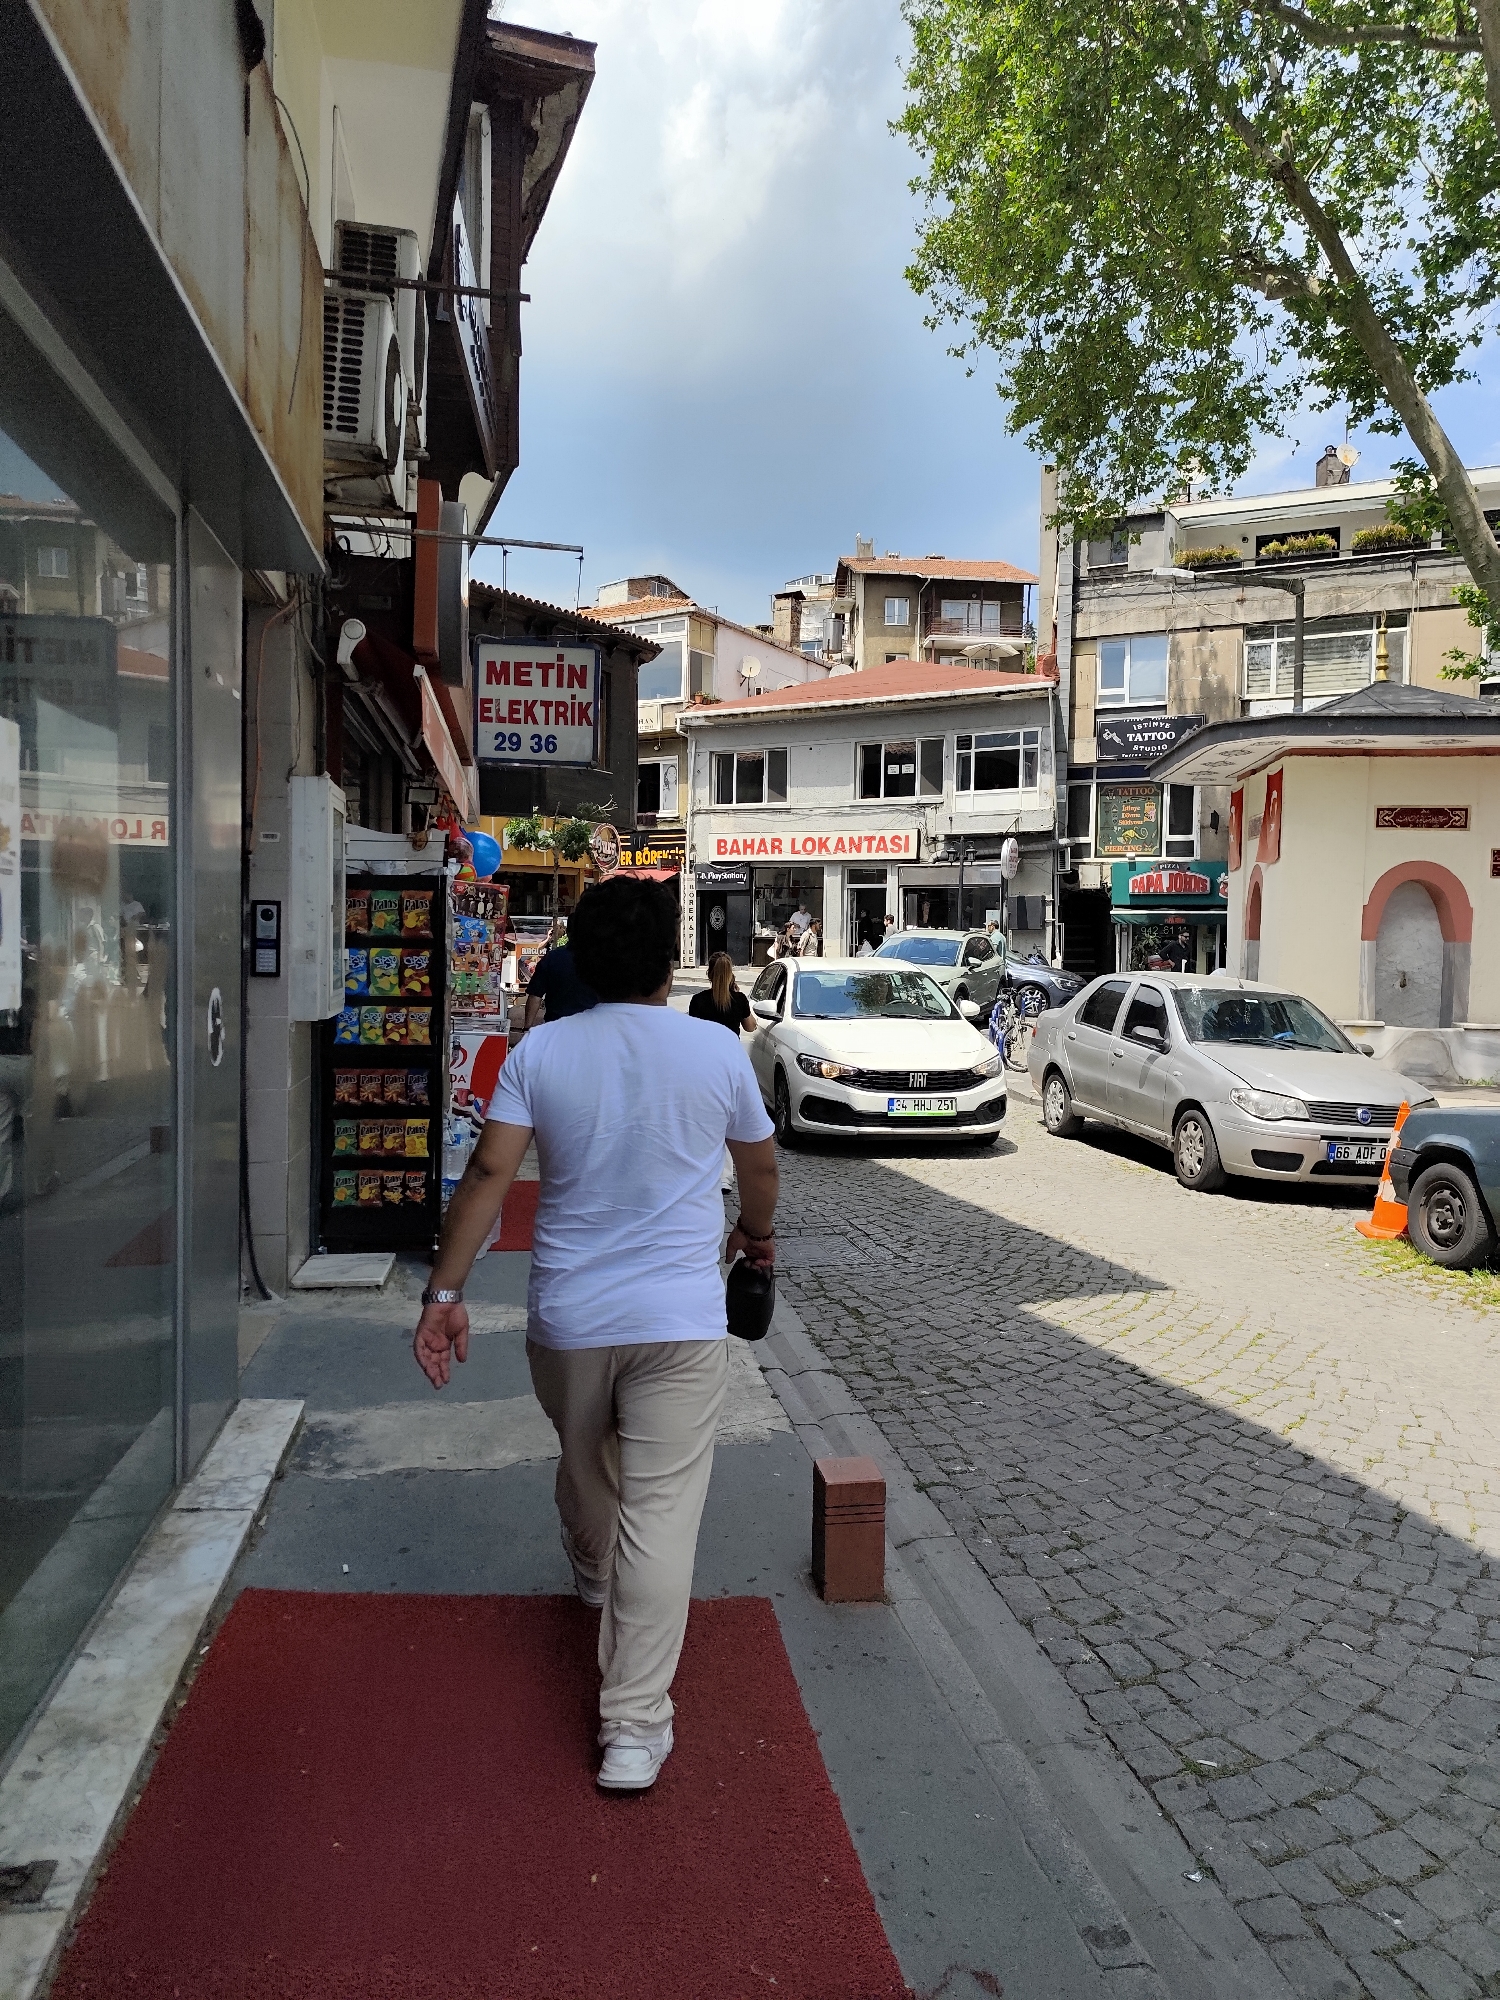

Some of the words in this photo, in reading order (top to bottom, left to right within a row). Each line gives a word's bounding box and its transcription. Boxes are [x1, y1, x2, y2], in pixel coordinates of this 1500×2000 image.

[486, 653, 588, 690] METİN
[479, 693, 594, 727] ELEKTRİK
[493, 731, 522, 752] 29
[529, 733, 558, 754] 36
[1126, 731, 1176, 742] TATTOO
[1118, 787, 1155, 796] TATTOO
[716, 837, 783, 856] BAHAR
[790, 834, 910, 855] LOKANTASI
[620, 850, 632, 866] ER
[1132, 874, 1163, 893] PAPA
[909, 1072, 928, 1088] FIAT
[895, 1099, 907, 1112] 34
[913, 1099, 932, 1112] HHJ
[937, 1099, 954, 1111] 251
[1336, 1146, 1350, 1159] 66
[1356, 1146, 1376, 1160] ADF
[1379, 1147, 1387, 1160] 0
